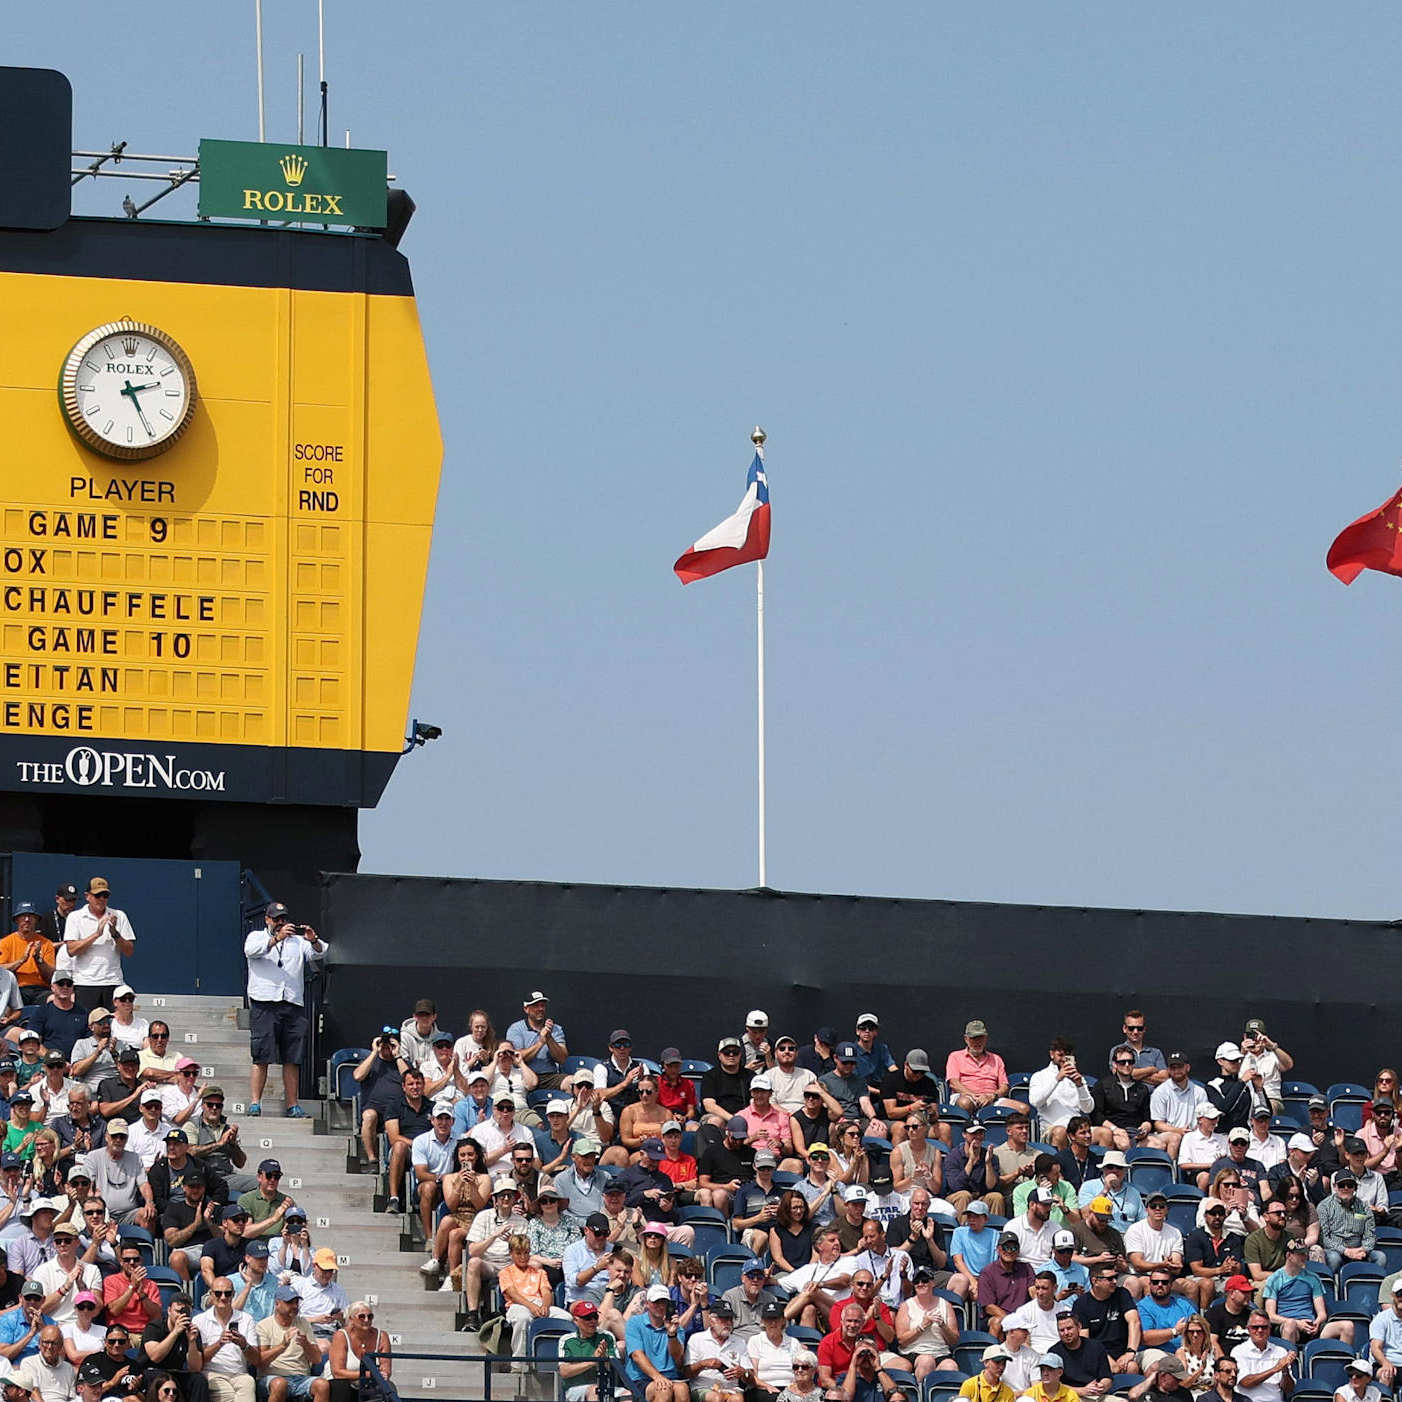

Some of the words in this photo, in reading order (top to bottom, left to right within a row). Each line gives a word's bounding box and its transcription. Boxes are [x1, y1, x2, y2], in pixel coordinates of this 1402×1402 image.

[243, 190, 344, 217] ROLEX
[106, 363, 155, 375] ROLEX
[295, 444, 343, 461] SCORE
[305, 468, 332, 483] FOR
[71, 478, 174, 502] PLAYER
[300, 491, 338, 511] RND
[29, 511, 120, 539] GAME
[150, 517, 168, 542] 9
[29, 626, 119, 654] GAME
[150, 632, 191, 658] 10
[871, 1206, 901, 1215] STAR
